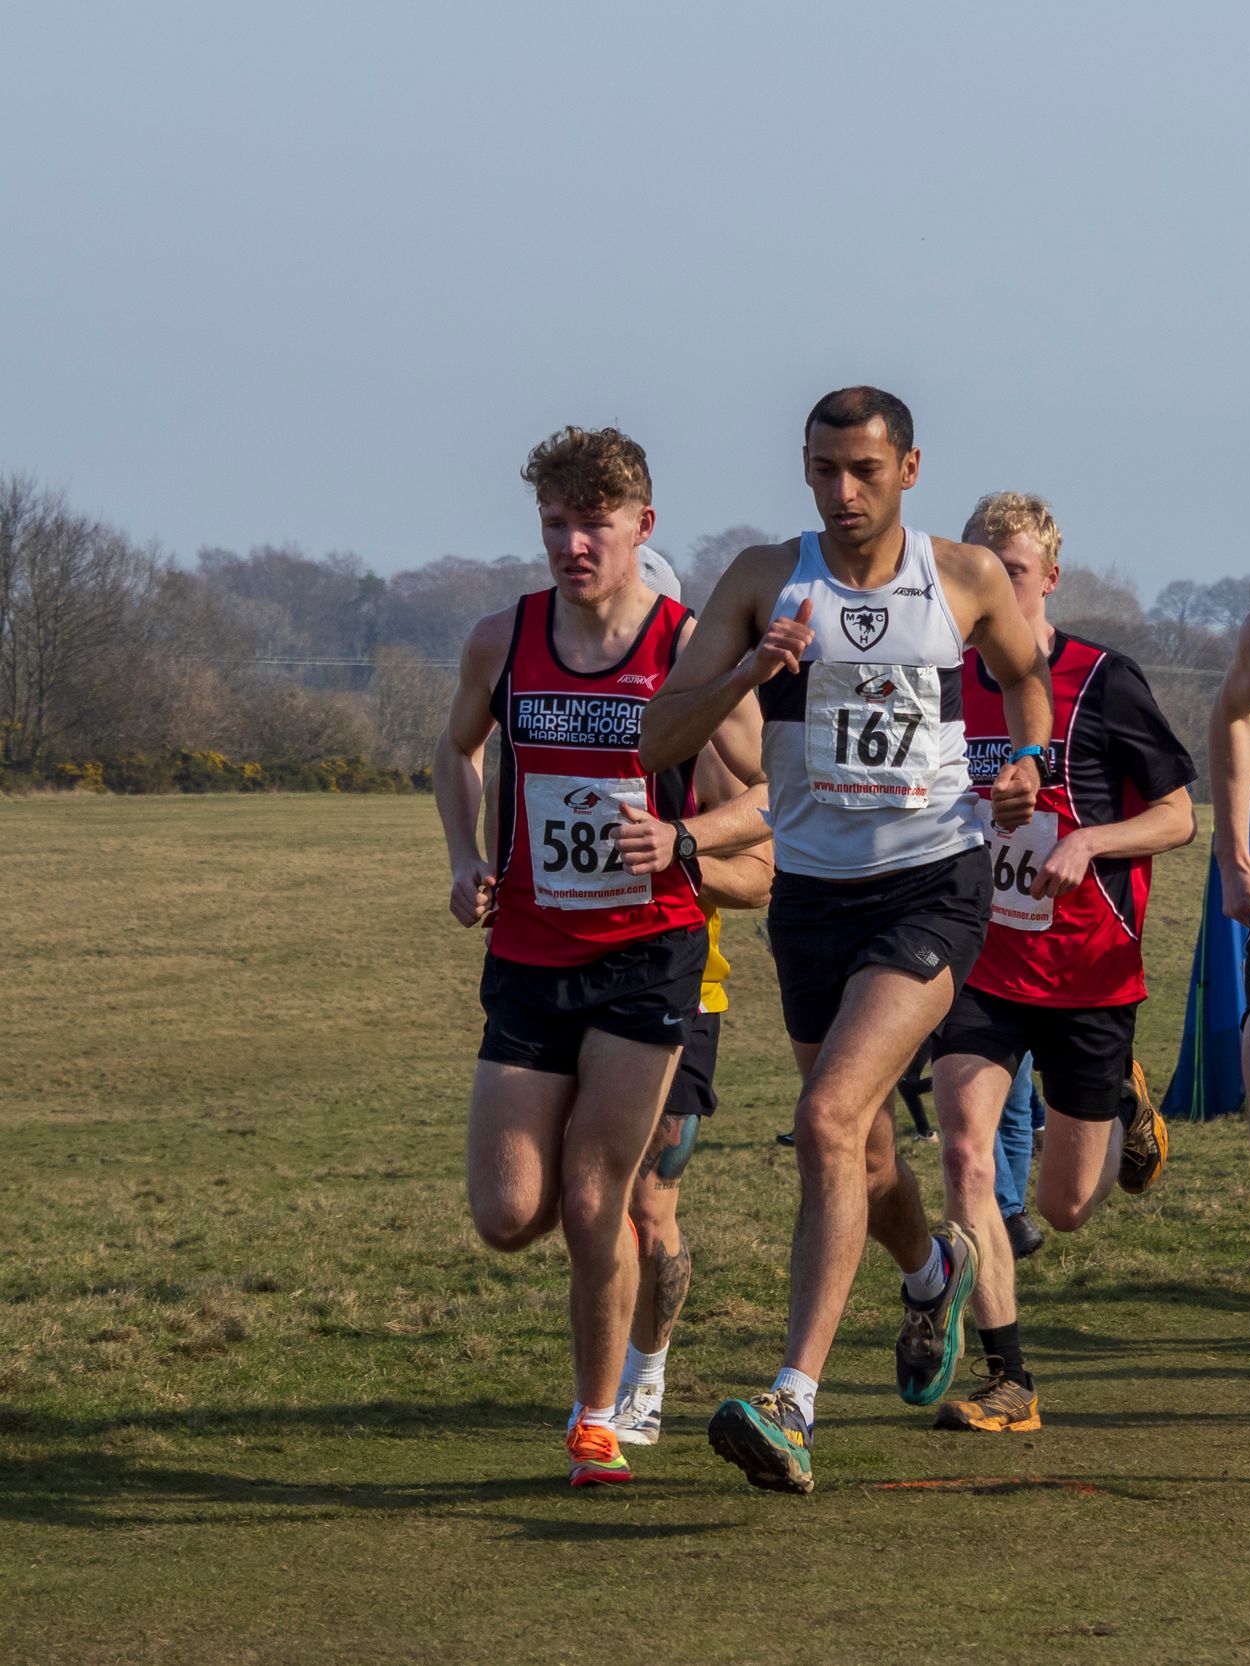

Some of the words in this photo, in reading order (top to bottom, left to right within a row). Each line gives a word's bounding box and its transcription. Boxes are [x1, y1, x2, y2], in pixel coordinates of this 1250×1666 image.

[846, 613, 855, 621] M
[875, 613, 884, 622] C
[860, 635, 868, 644] H
[518, 714, 582, 732] MARSH
[529, 729, 595, 743] HARRIERS
[608, 734, 634, 745] A.C.
[835, 708, 923, 767] 167
[813, 780, 928, 797] www.northernrunner.com
[543, 820, 624, 873] 582
[984, 840, 1038, 896] 66
[538, 884, 647, 899] www.northernrunner.com
